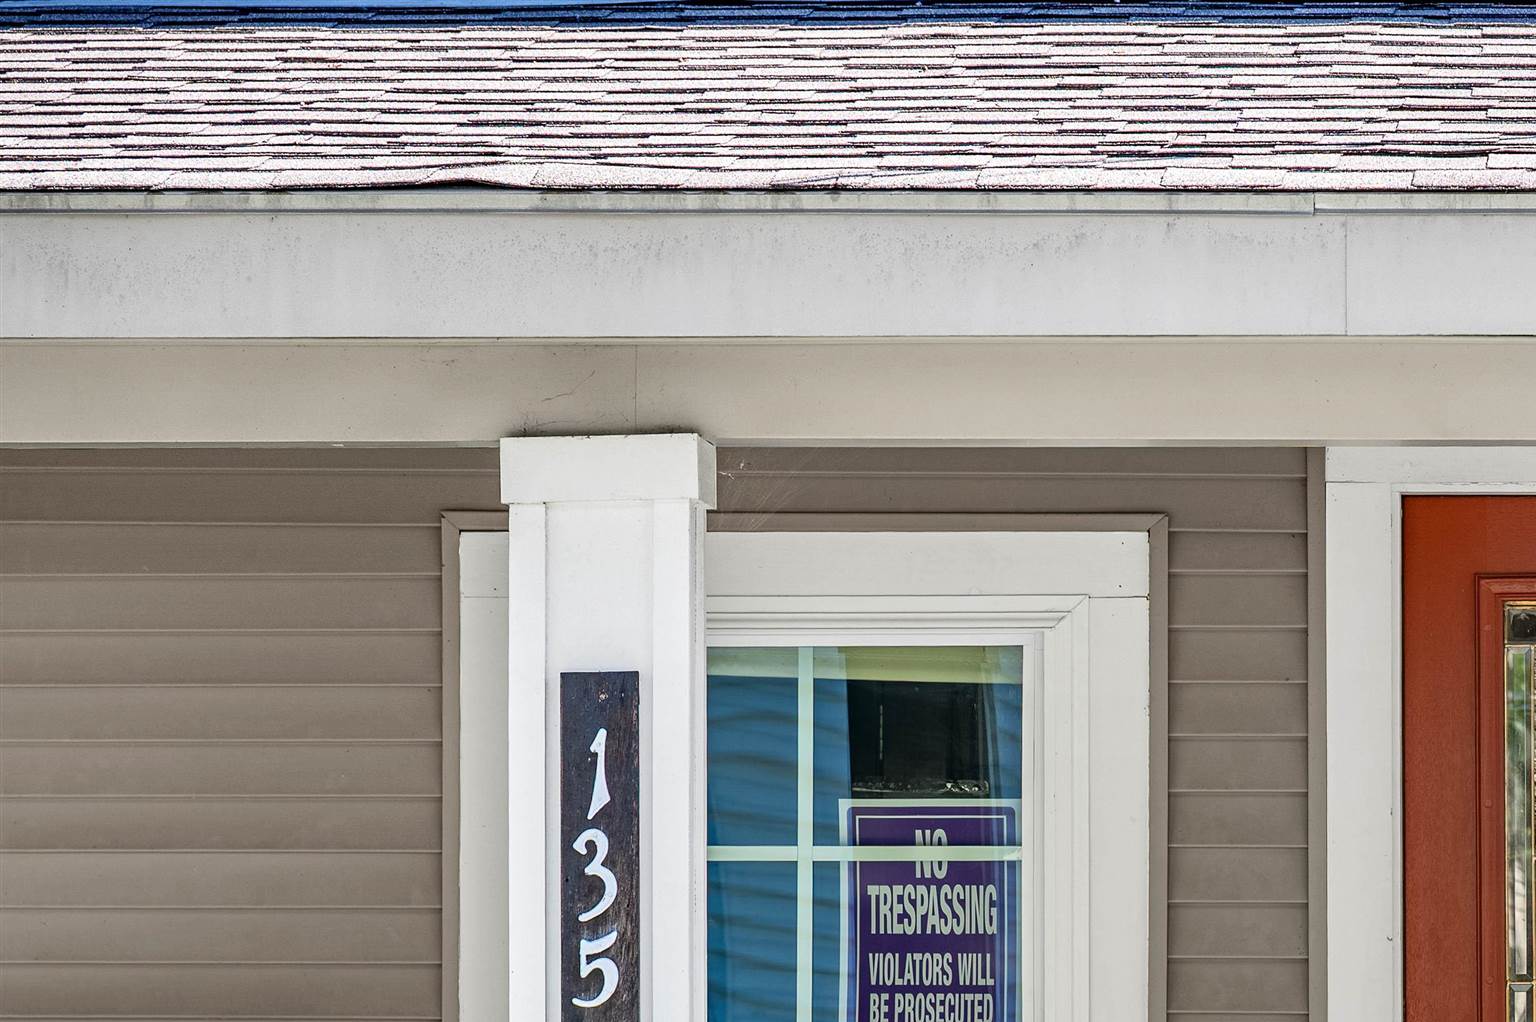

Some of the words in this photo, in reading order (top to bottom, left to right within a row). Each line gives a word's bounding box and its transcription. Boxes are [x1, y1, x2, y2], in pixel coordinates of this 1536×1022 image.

[572, 728, 619, 1008] 135
[914, 828, 949, 879] NO
[867, 884, 998, 936] TRESPASSING
[868, 952, 953, 986] VIOLATORS
[957, 952, 995, 986] WILL
